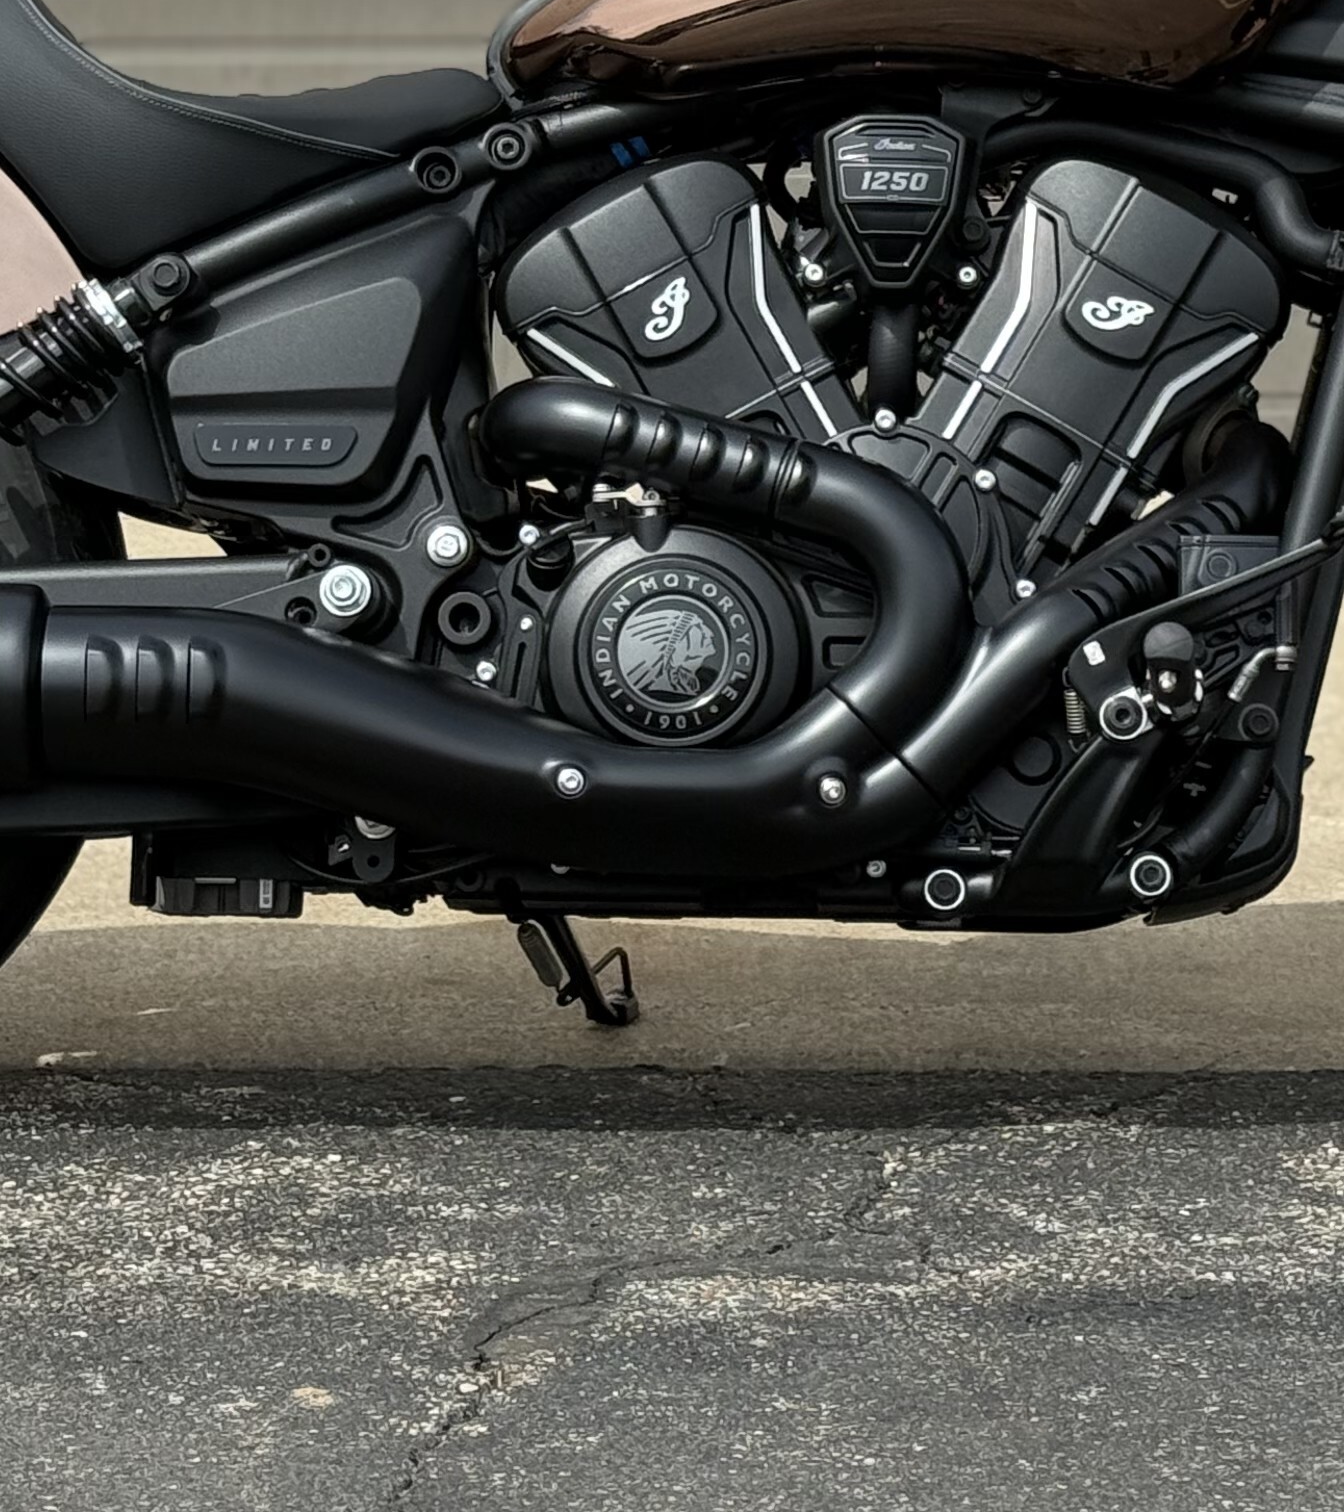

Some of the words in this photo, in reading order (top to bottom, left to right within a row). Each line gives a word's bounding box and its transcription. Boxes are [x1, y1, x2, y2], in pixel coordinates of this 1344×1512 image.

[860, 170, 930, 193] 1250
[210, 437, 334, 453] LIMITED
[594, 596, 632, 700] INDIAN
[639, 572, 753, 702] MOTORCYCLE
[643, 713, 704, 730] 1901
